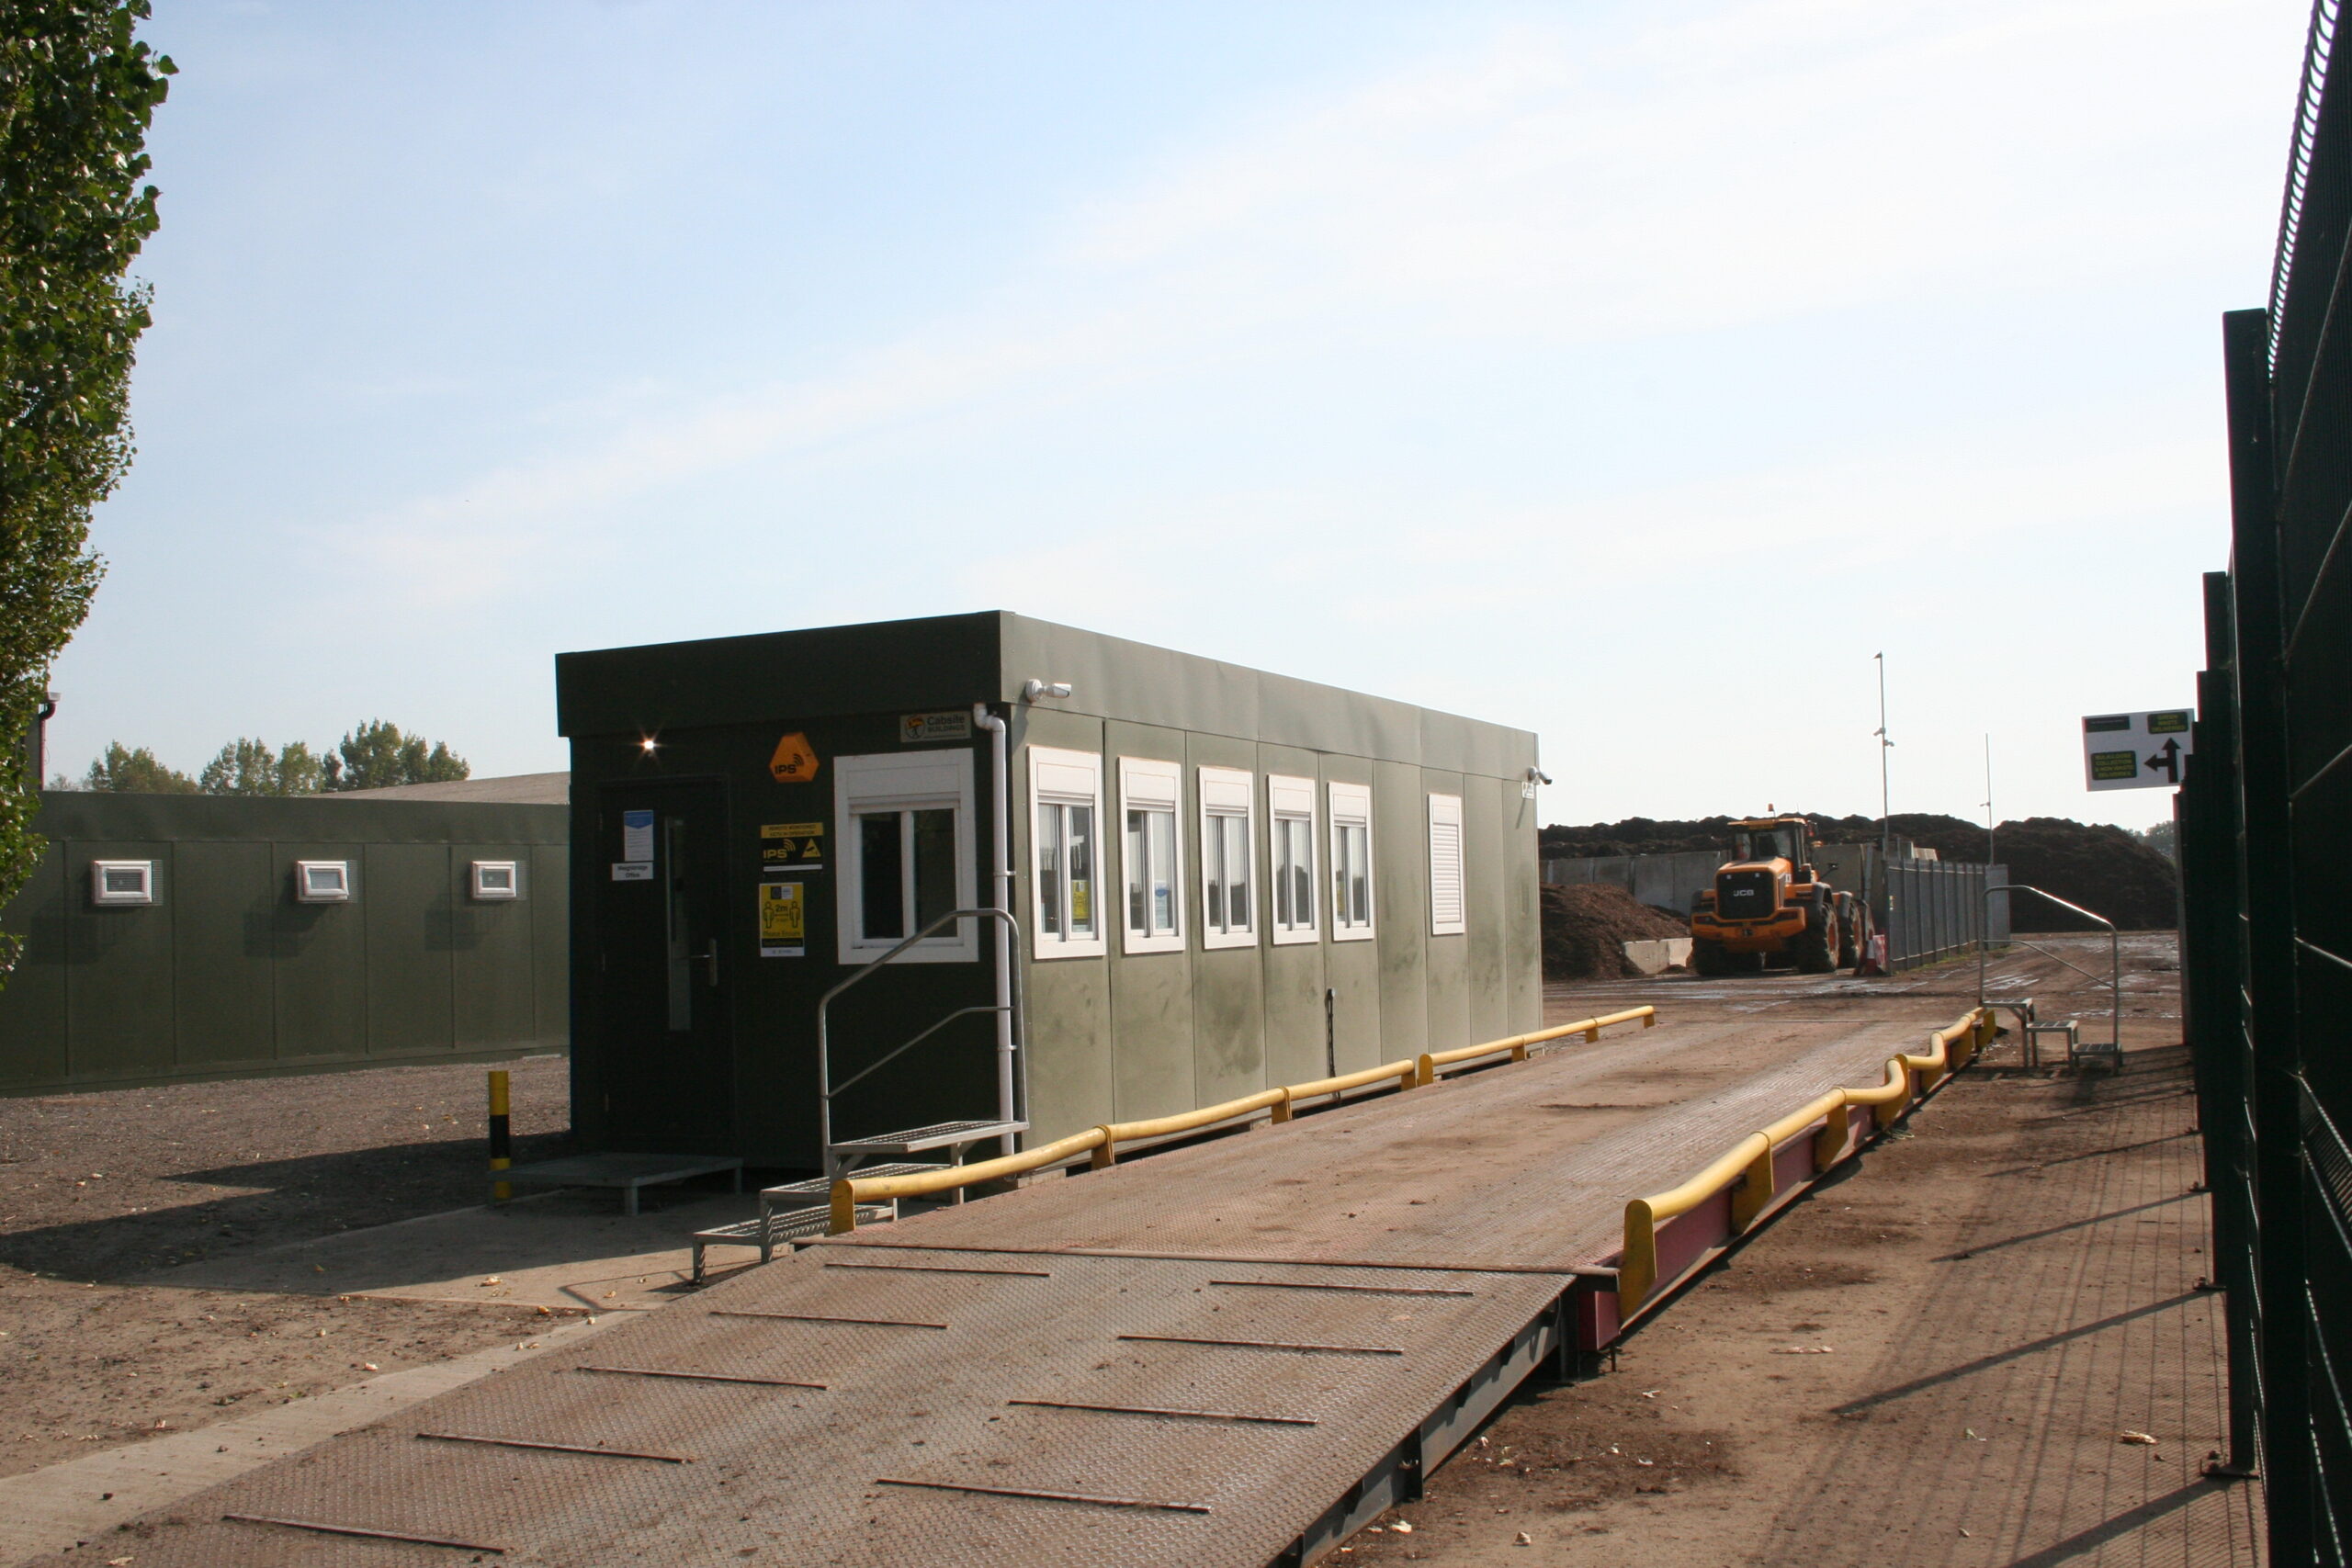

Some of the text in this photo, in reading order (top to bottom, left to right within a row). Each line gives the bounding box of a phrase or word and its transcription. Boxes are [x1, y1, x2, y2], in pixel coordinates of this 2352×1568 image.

[927, 714, 965, 726] Cabsite
[775, 764, 797, 775] IPS
[763, 849, 787, 859] IPS
[775, 904, 788, 912] 2m
